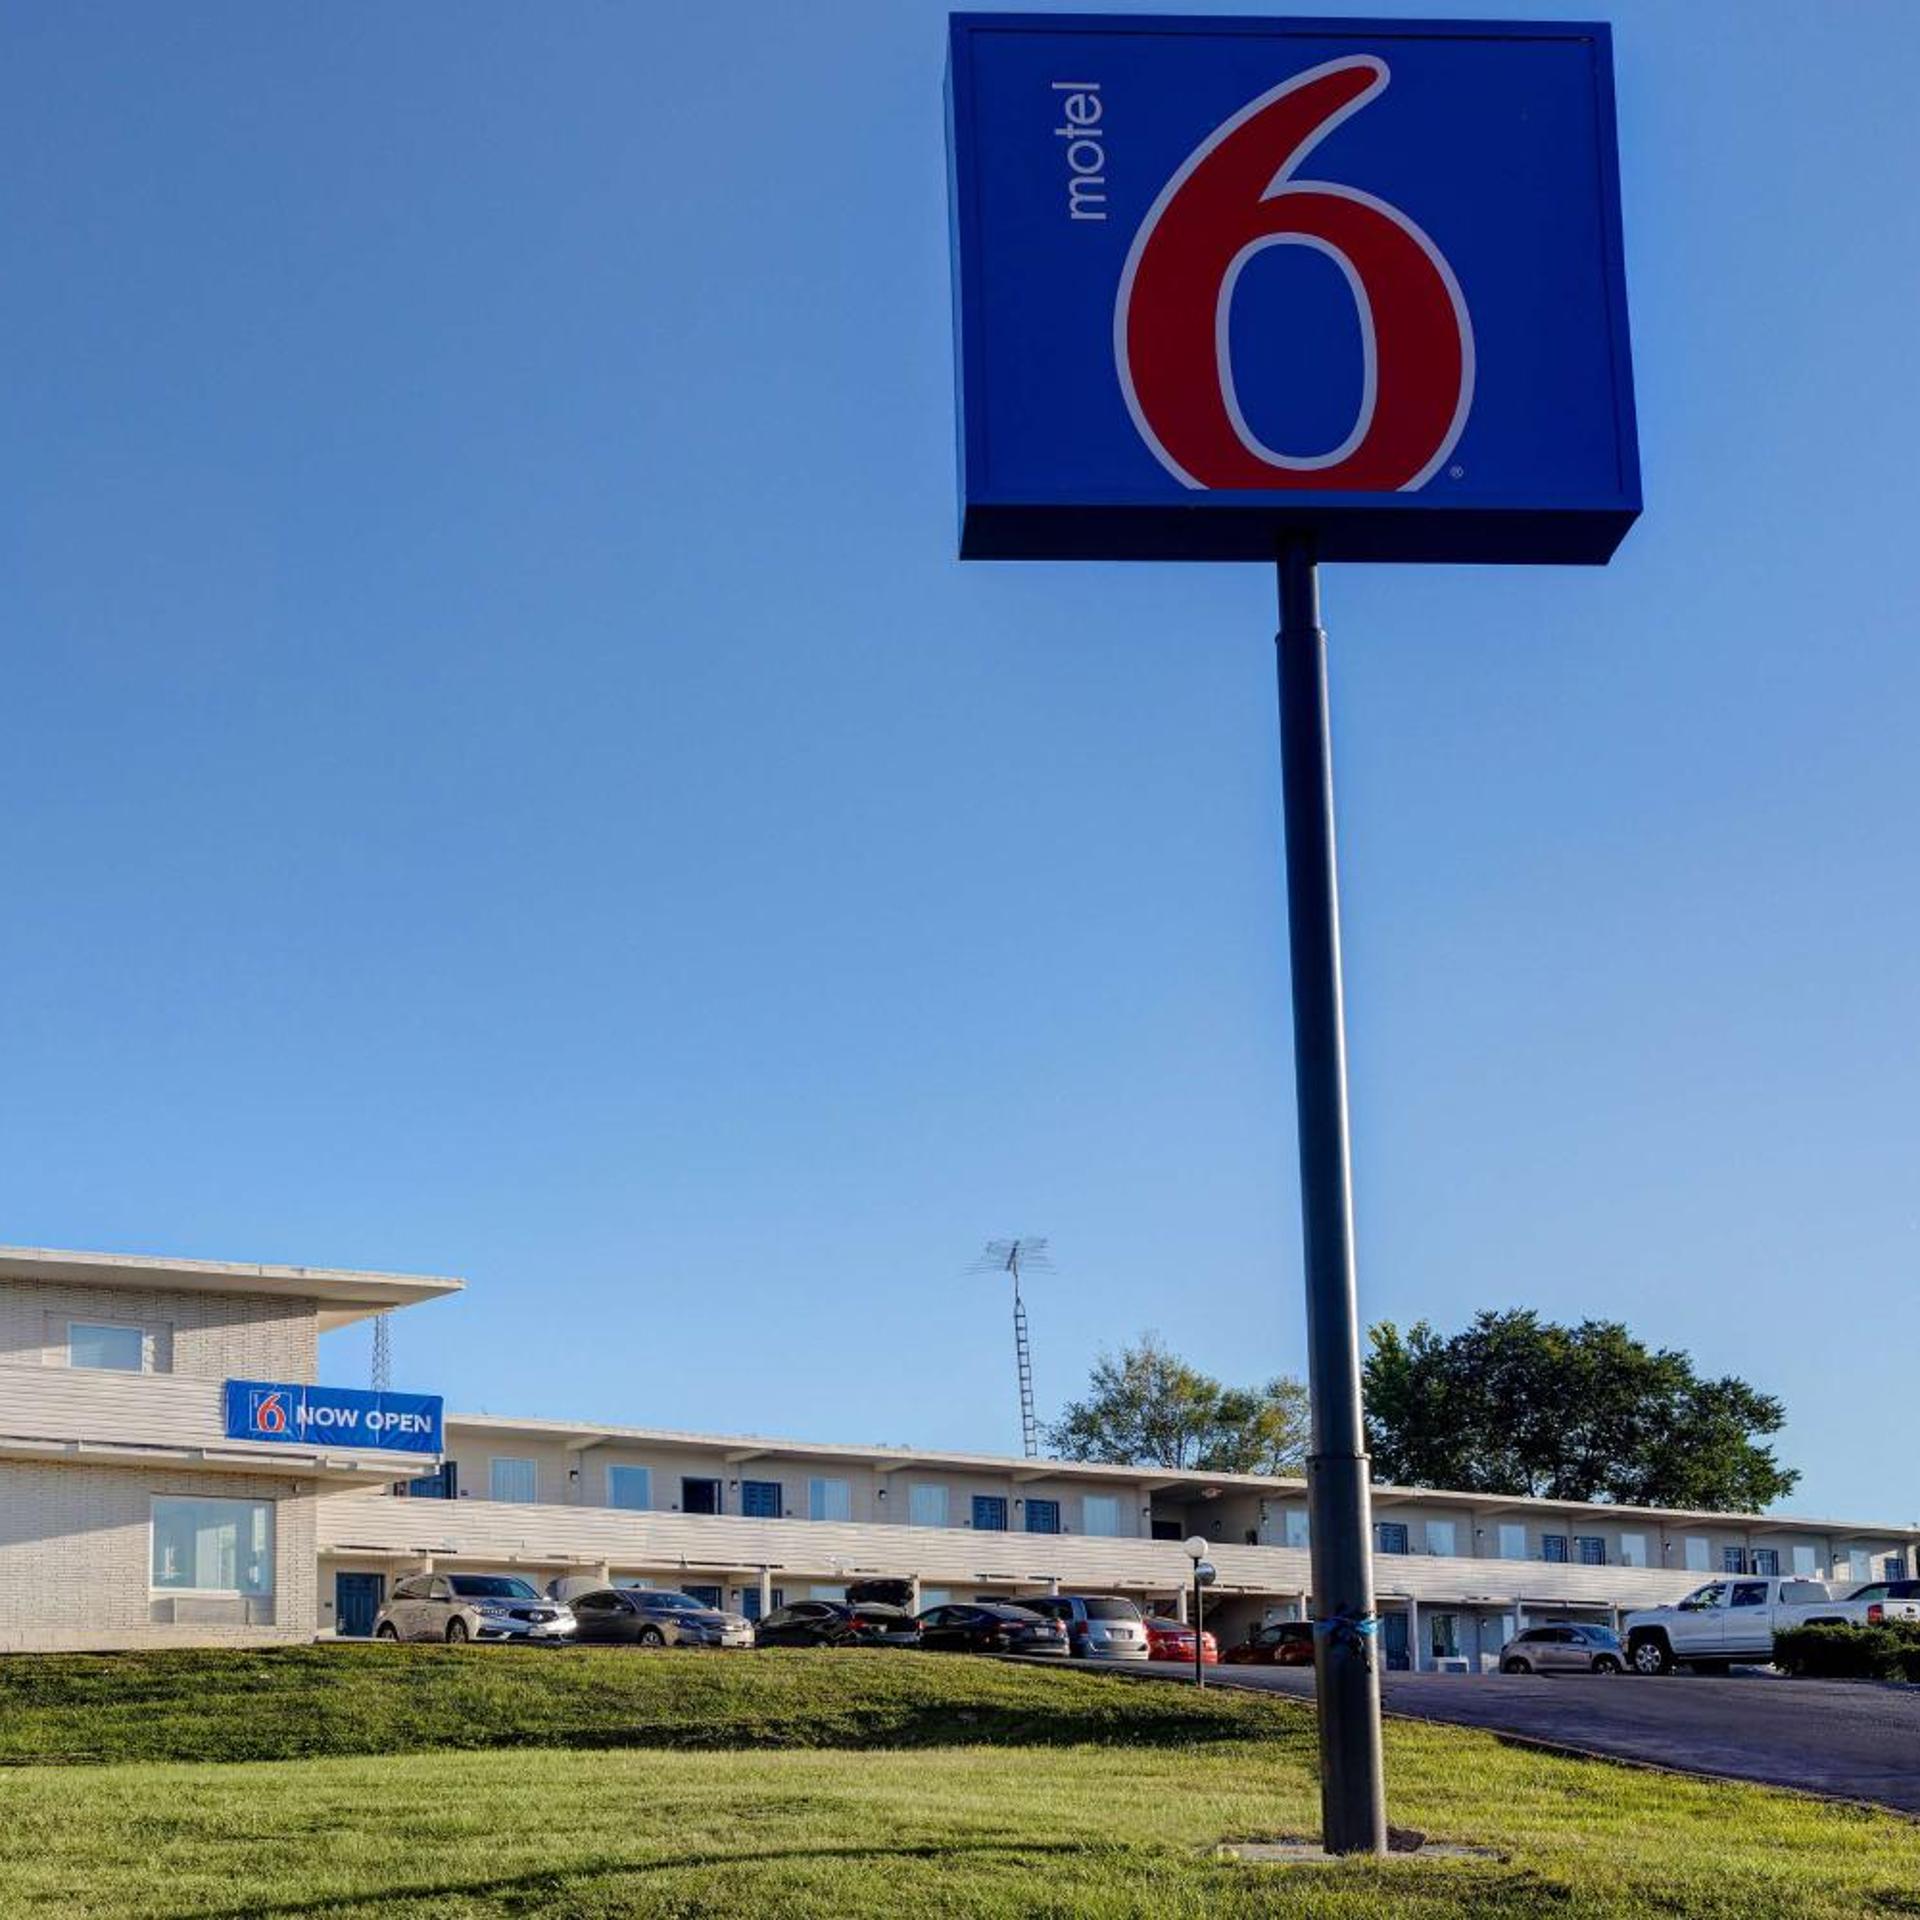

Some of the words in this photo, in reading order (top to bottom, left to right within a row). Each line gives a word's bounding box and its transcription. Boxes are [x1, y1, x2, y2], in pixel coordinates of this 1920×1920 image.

[1052, 82, 1107, 219] motel
[1113, 54, 1475, 492] 6
[257, 1393, 287, 1433] 6
[296, 1405, 359, 1427] NOW
[366, 1411, 432, 1433] OPEN
